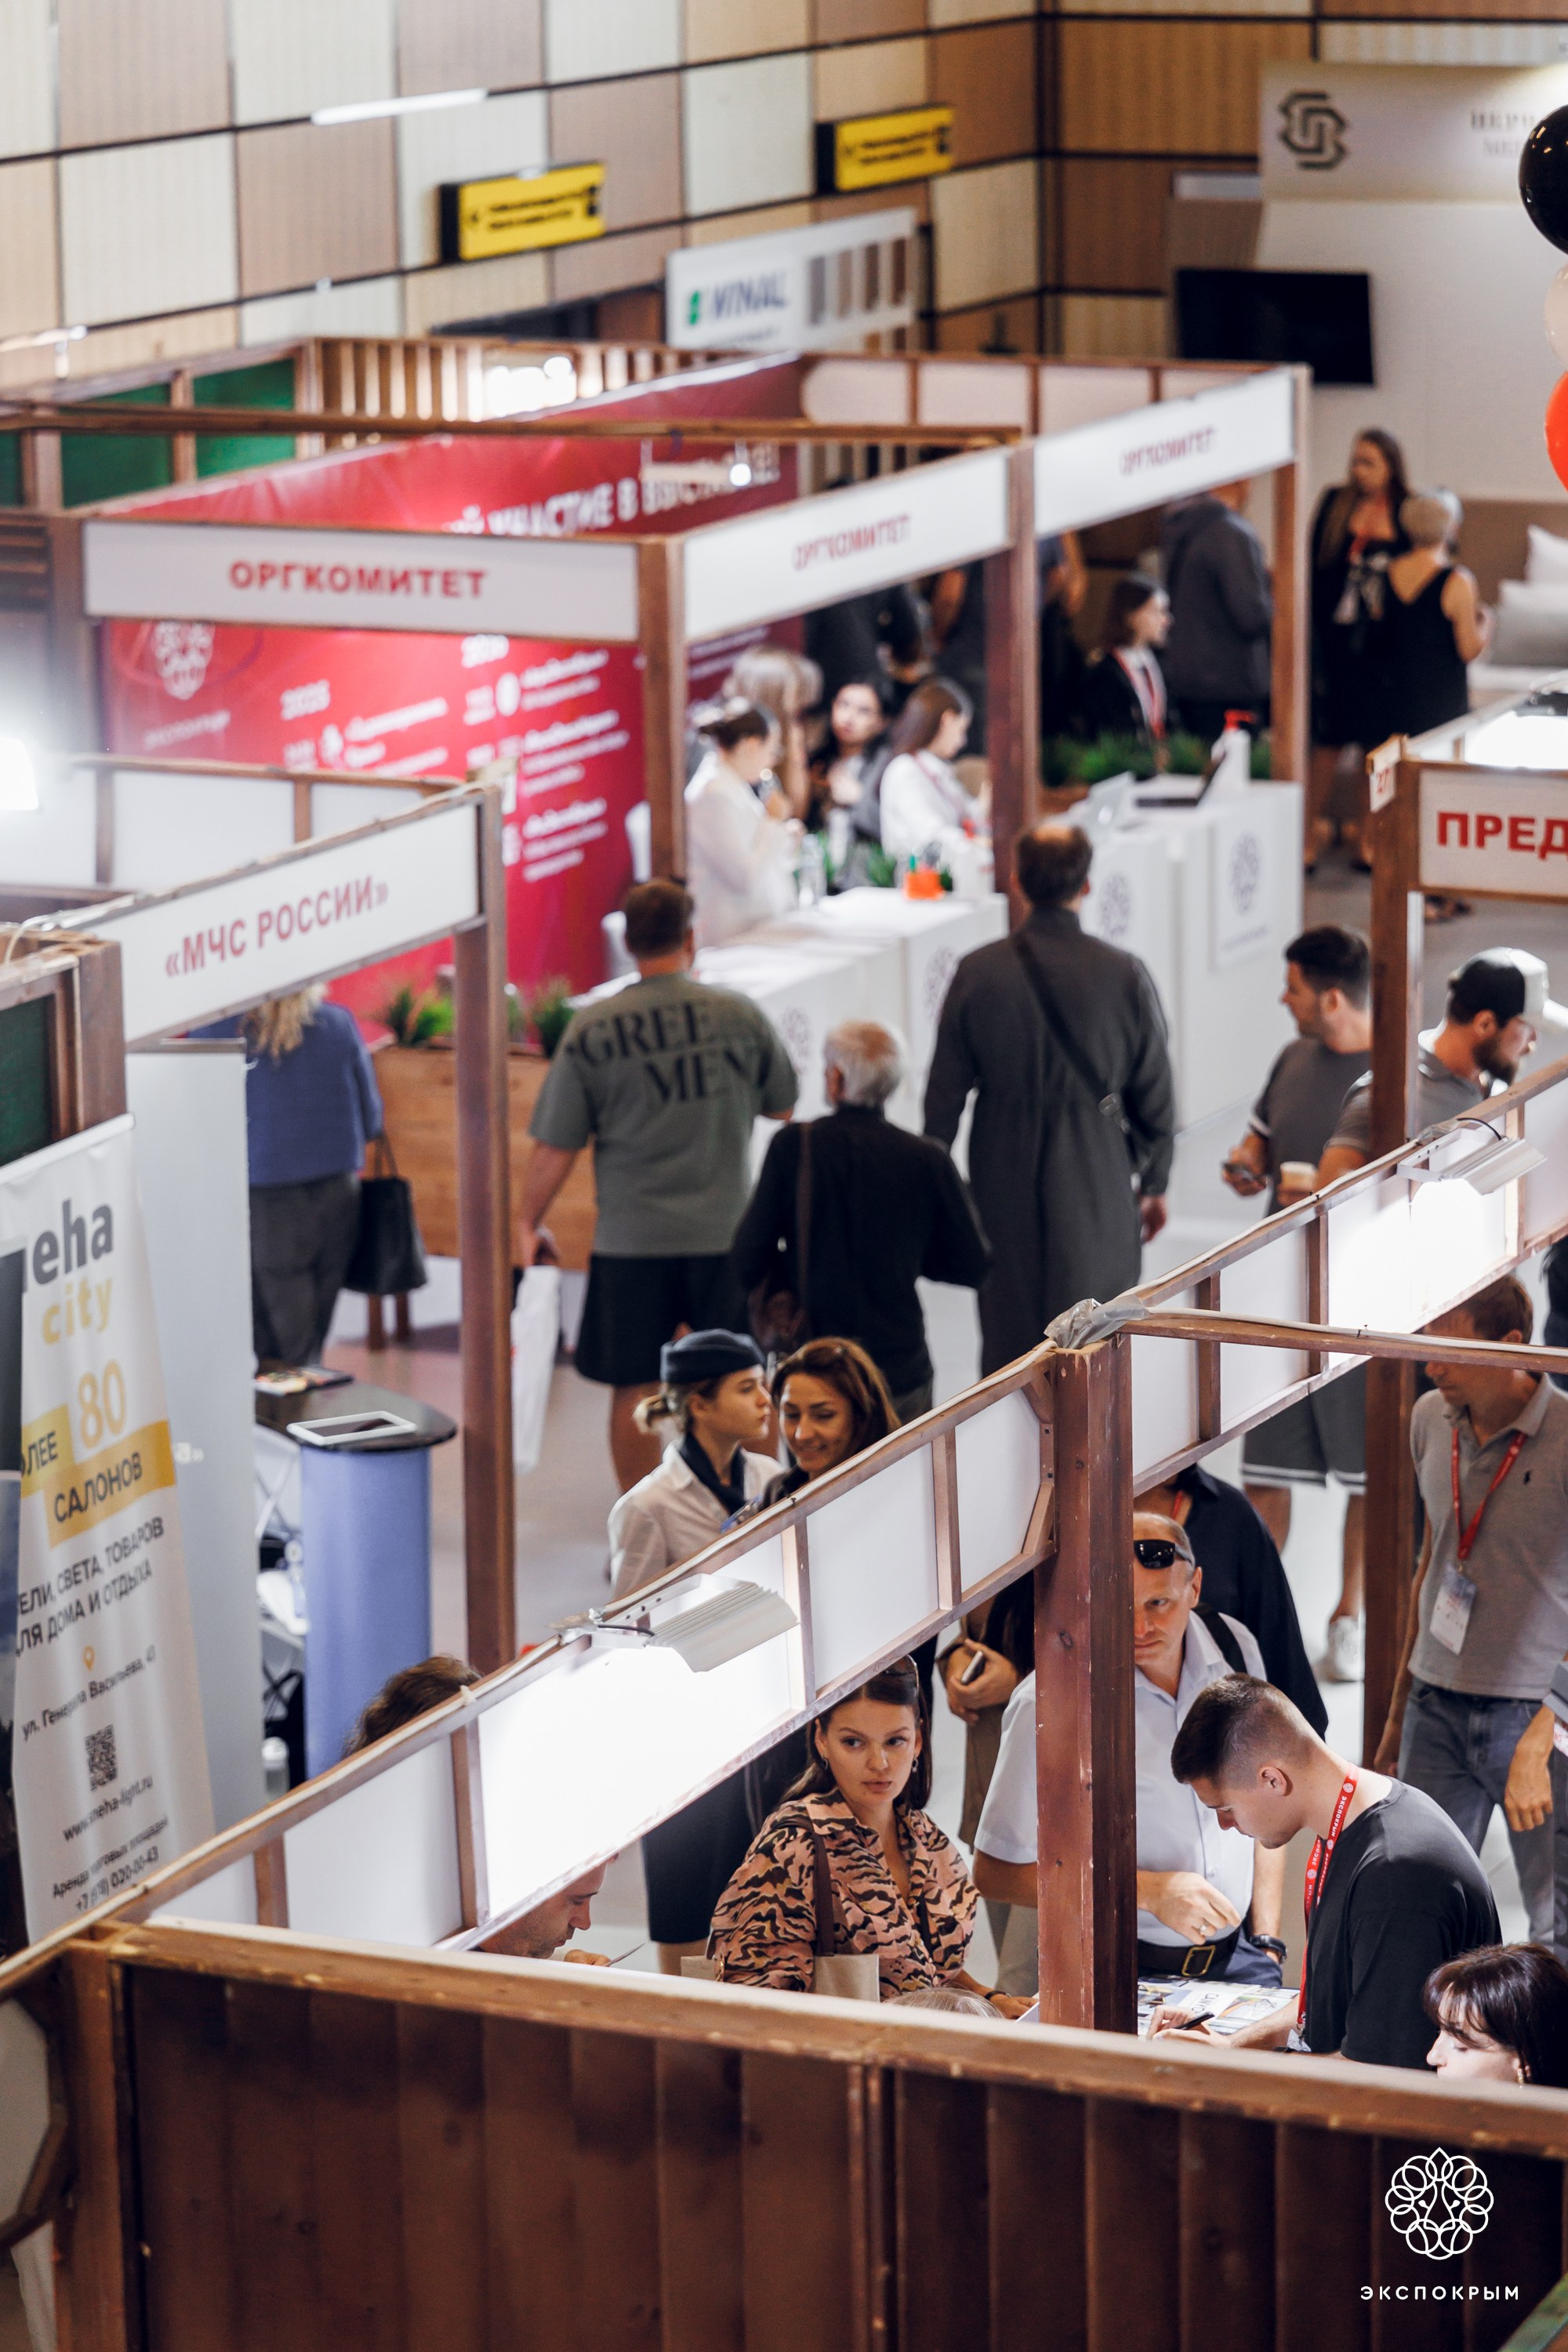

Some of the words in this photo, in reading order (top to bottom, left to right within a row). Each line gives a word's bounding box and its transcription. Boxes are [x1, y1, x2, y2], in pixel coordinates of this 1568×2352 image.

[230, 560, 485, 598] ОРГКОМИТЕТ
[165, 920, 245, 978] «МЧС
[258, 876, 389, 949] РОССИИ»
[24, 1198, 114, 1292] eha
[42, 1276, 112, 1346] city
[78, 1358, 127, 1448] 80
[54, 1451, 143, 1523] САЛОНОВ
[105, 1516, 164, 1566] ТОВАРОВ
[16, 1623, 43, 1657] ЛЯ
[48, 1598, 85, 1643] ДОМА
[89, 1589, 101, 1613] И
[103, 1559, 153, 1604] ОТДЫХА
[1331, 1796, 1347, 1837] ЭКСПОКРЫМ
